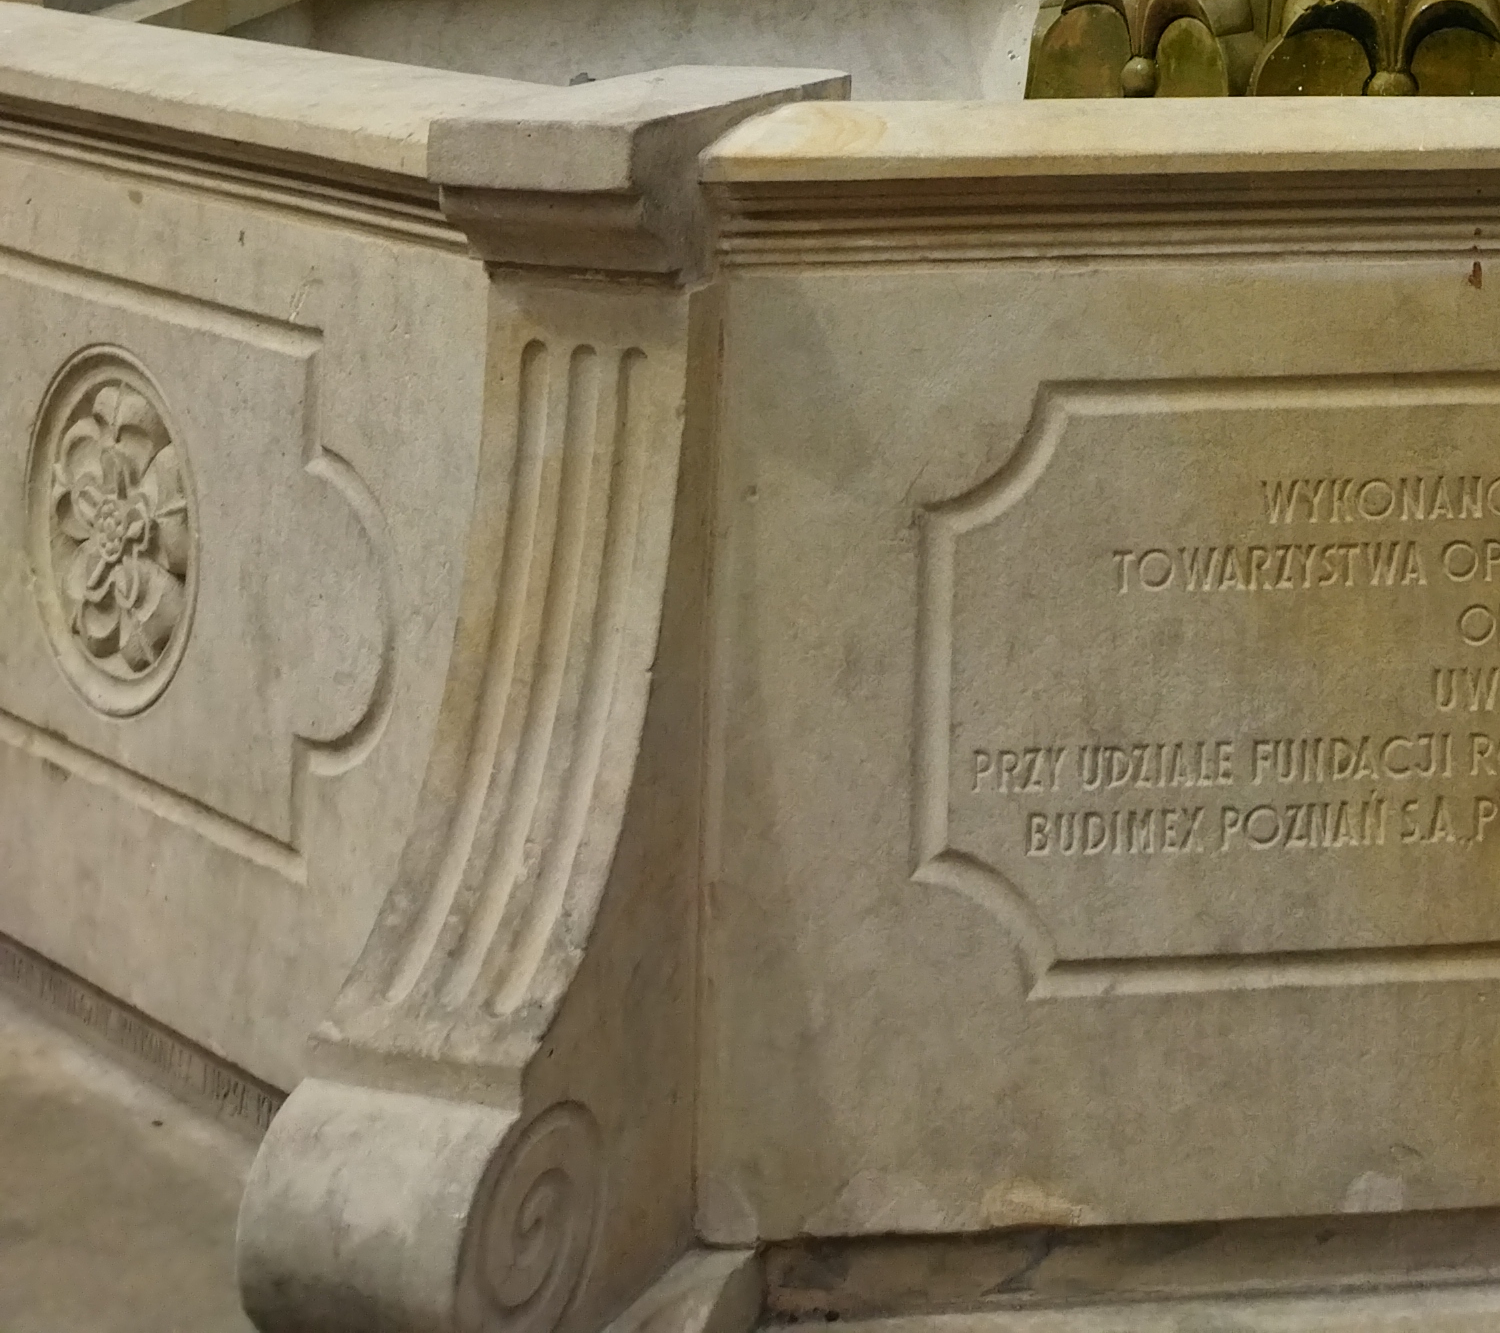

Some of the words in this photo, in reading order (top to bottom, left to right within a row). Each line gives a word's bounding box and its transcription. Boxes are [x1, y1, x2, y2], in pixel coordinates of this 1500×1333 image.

[1112, 540, 1427, 595] TOWARZYSTWA
[972, 745, 1069, 794] PRZY
[1252, 733, 1451, 785] FUNDACJI
[1025, 805, 1206, 858] BUDIMEX
[1220, 788, 1389, 852] POZNAŃ
